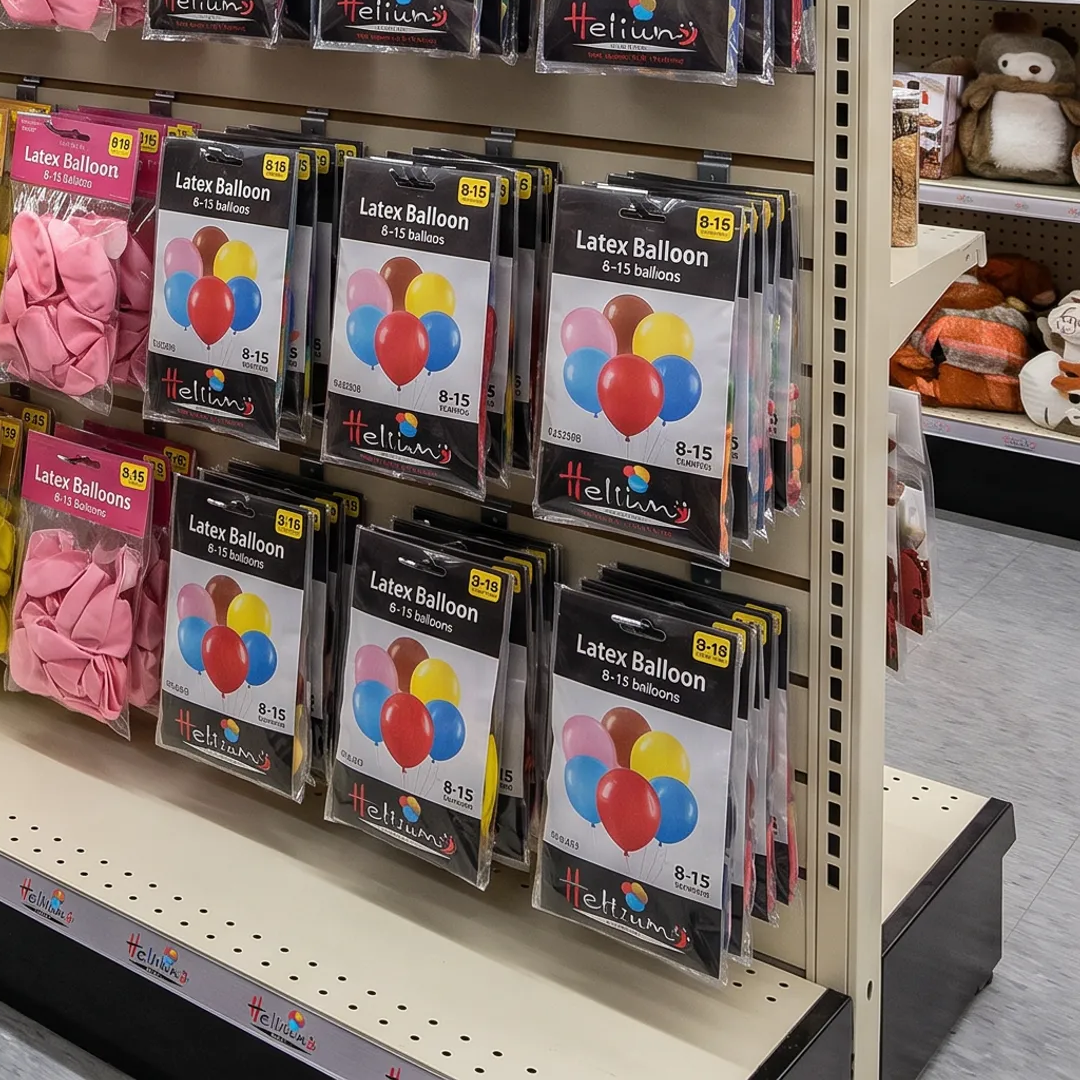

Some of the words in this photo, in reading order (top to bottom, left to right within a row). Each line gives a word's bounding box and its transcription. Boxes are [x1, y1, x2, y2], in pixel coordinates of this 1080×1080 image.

[23, 146, 60, 168] Latex
[62, 152, 120, 179] Balloon
[175, 171, 213, 194] Latex
[215, 177, 271, 202] Balloon
[460, 183, 488, 198] 8-15
[359, 196, 403, 222] Latex
[405, 203, 470, 231] Balloon
[699, 215, 731, 232] 8-15
[575, 228, 629, 257] Latex
[633, 237, 709, 267] Balloon
[601, 259, 631, 276] 8-15
[241, 347, 270, 364] 8-15
[438, 389, 471, 407] 8-15
[675, 440, 713, 462] 8-15
[35, 464, 70, 491] Latex
[72, 476, 132, 512] Balloons
[189, 514, 226, 543] Latex
[228, 526, 285, 560] Balloon
[369, 570, 413, 602] Latex
[414, 585, 479, 624] Balloon
[575, 633, 628, 669] Latex
[631, 650, 708, 693] Balloon
[442, 779, 475, 802] 8-15
[673, 864, 711, 890] 8-15
